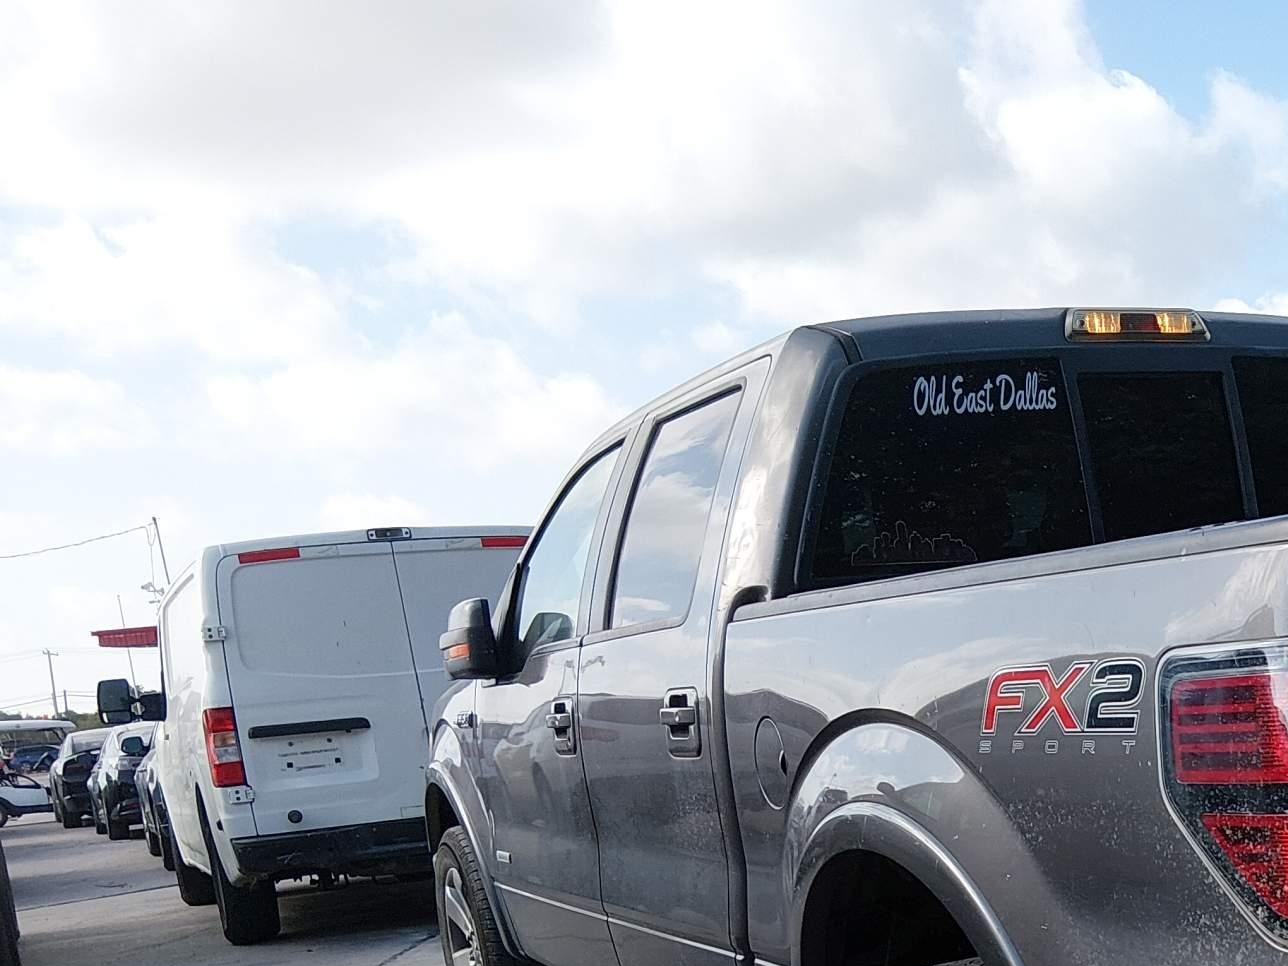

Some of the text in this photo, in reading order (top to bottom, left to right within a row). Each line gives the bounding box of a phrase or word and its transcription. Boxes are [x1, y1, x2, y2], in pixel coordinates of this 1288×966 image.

[913, 371, 1057, 416] Old East Dallas
[980, 657, 1147, 736] FX2
[978, 740, 1137, 755] SPORT
